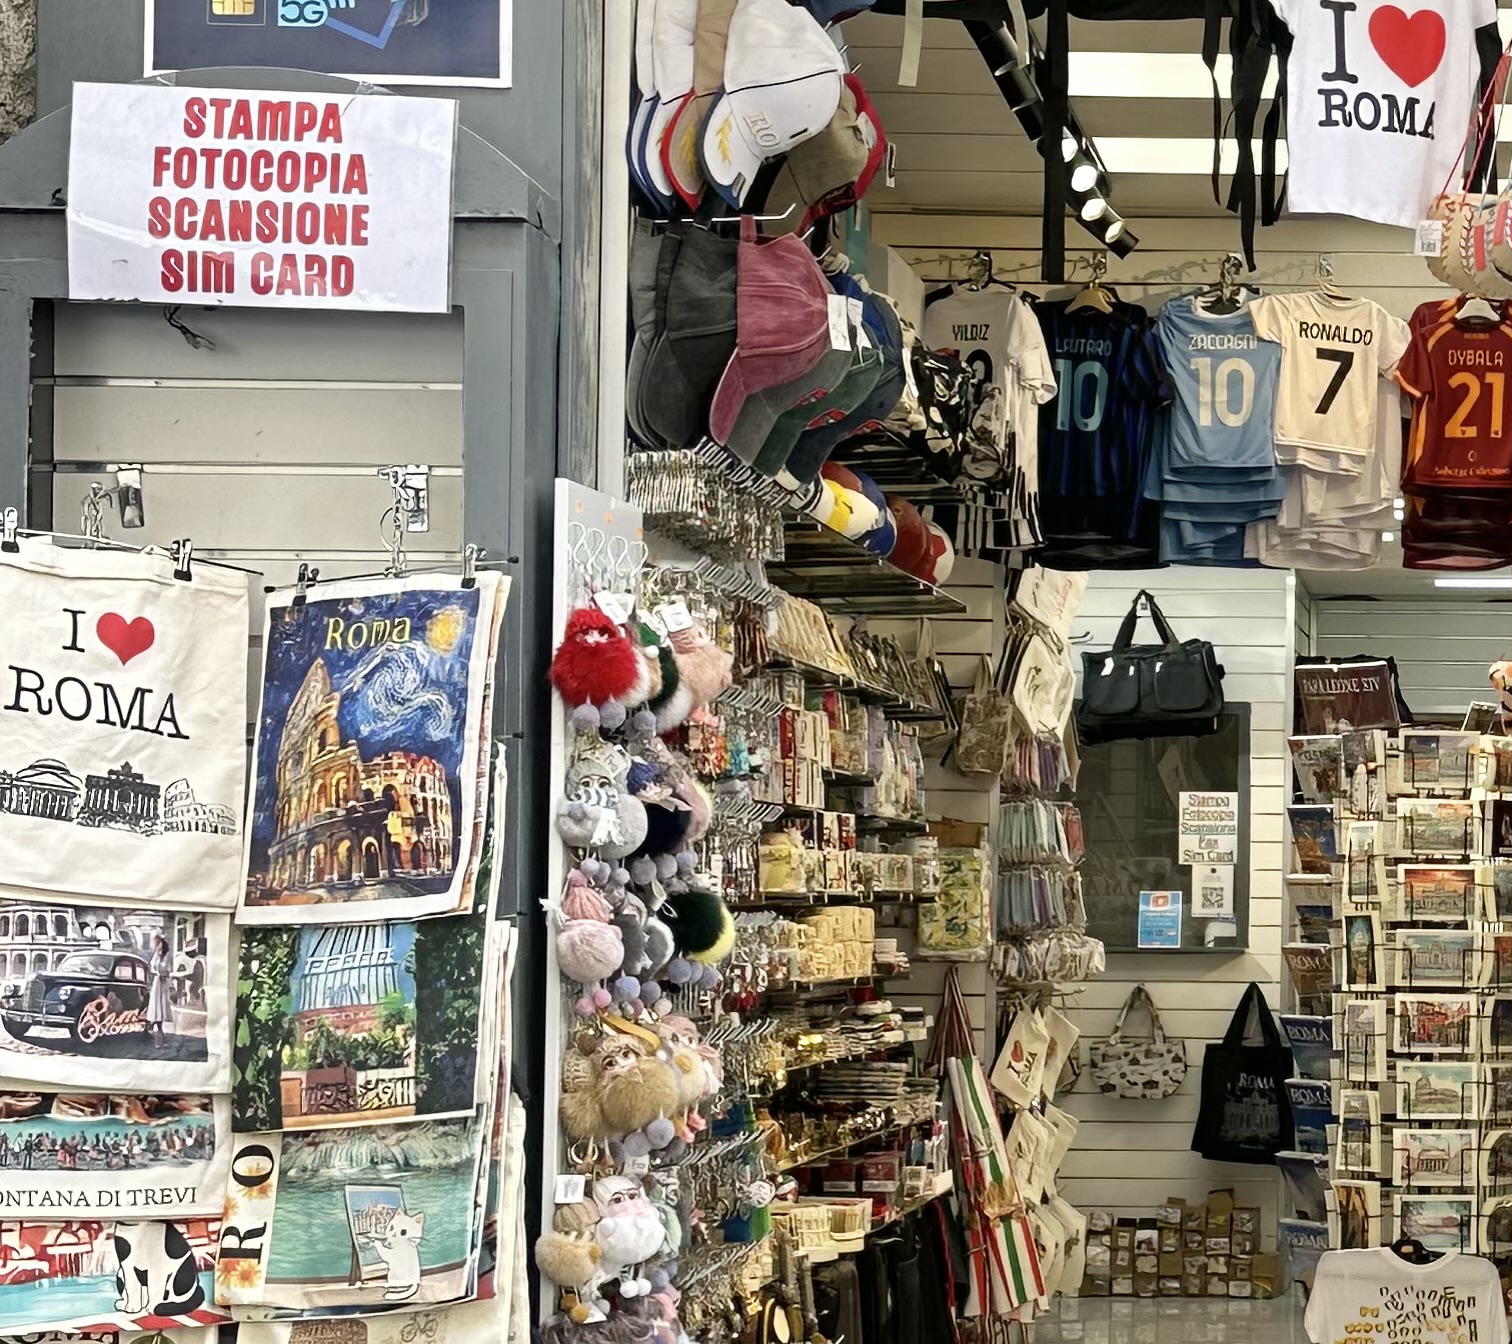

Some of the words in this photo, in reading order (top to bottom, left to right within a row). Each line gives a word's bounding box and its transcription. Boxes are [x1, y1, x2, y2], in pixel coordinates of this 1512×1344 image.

[1319, 0, 1359, 85] I
[183, 97, 343, 143] STAMPA
[1317, 88, 1436, 141] ROMA
[153, 147, 368, 195] FOTOCOPIA
[147, 197, 369, 246] SCANSIONE
[161, 248, 234, 295] SIM
[250, 252, 354, 298] CARD
[952, 324, 990, 341] YILDIZ
[1055, 338, 1112, 355] LAUTARO
[1299, 321, 1373, 346] RONALDO
[1315, 348, 1354, 414] 7
[1449, 349, 1503, 366] DYBALA
[1056, 358, 1108, 431] 10
[1190, 357, 1255, 427] 10
[1445, 372, 1504, 438] 21
[62, 609, 87, 652] I
[324, 614, 411, 651] Roma
[4, 666, 190, 740] ROMA
[0, 1190, 91, 1206] NTANA
[96, 1190, 119, 1207] DI
[127, 1187, 197, 1205] TREVI
[219, 1144, 275, 1265] RO
